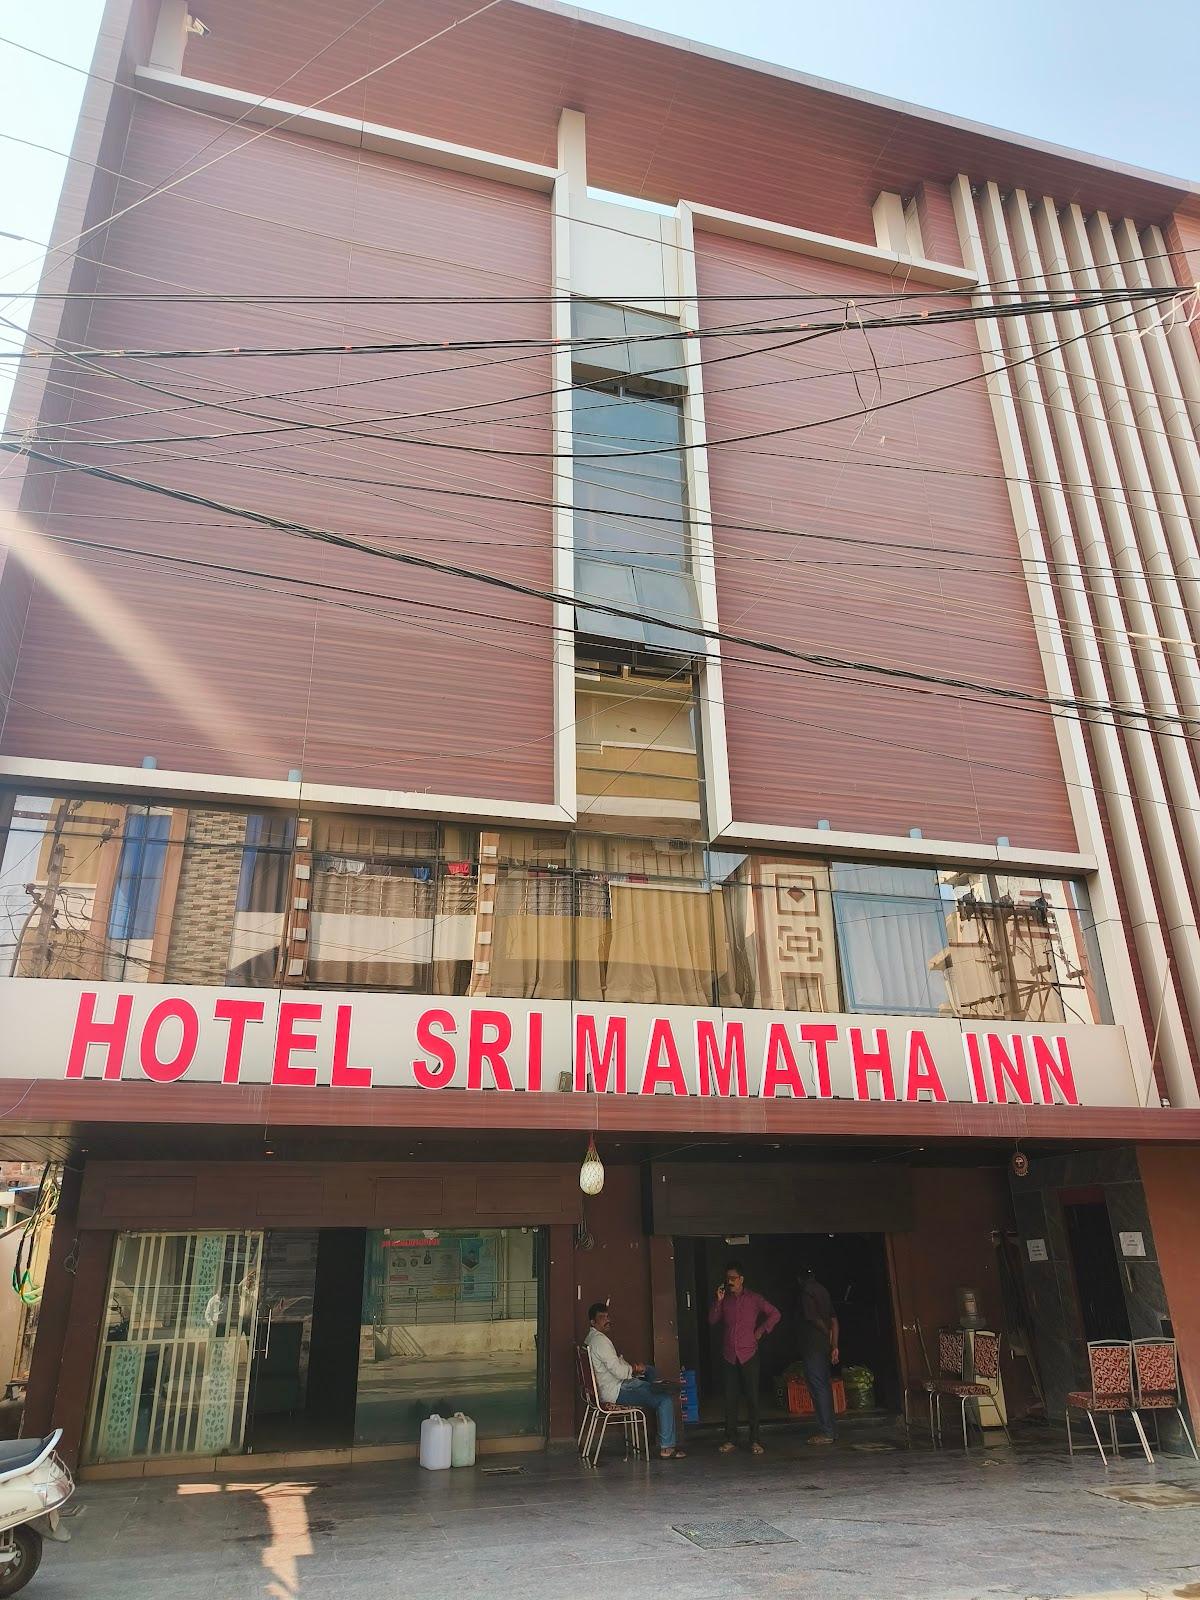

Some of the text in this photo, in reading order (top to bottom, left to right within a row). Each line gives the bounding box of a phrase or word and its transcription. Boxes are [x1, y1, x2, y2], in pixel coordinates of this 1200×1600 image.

[65, 991, 1079, 1105] HOTEL SRI MAMATHA INN
